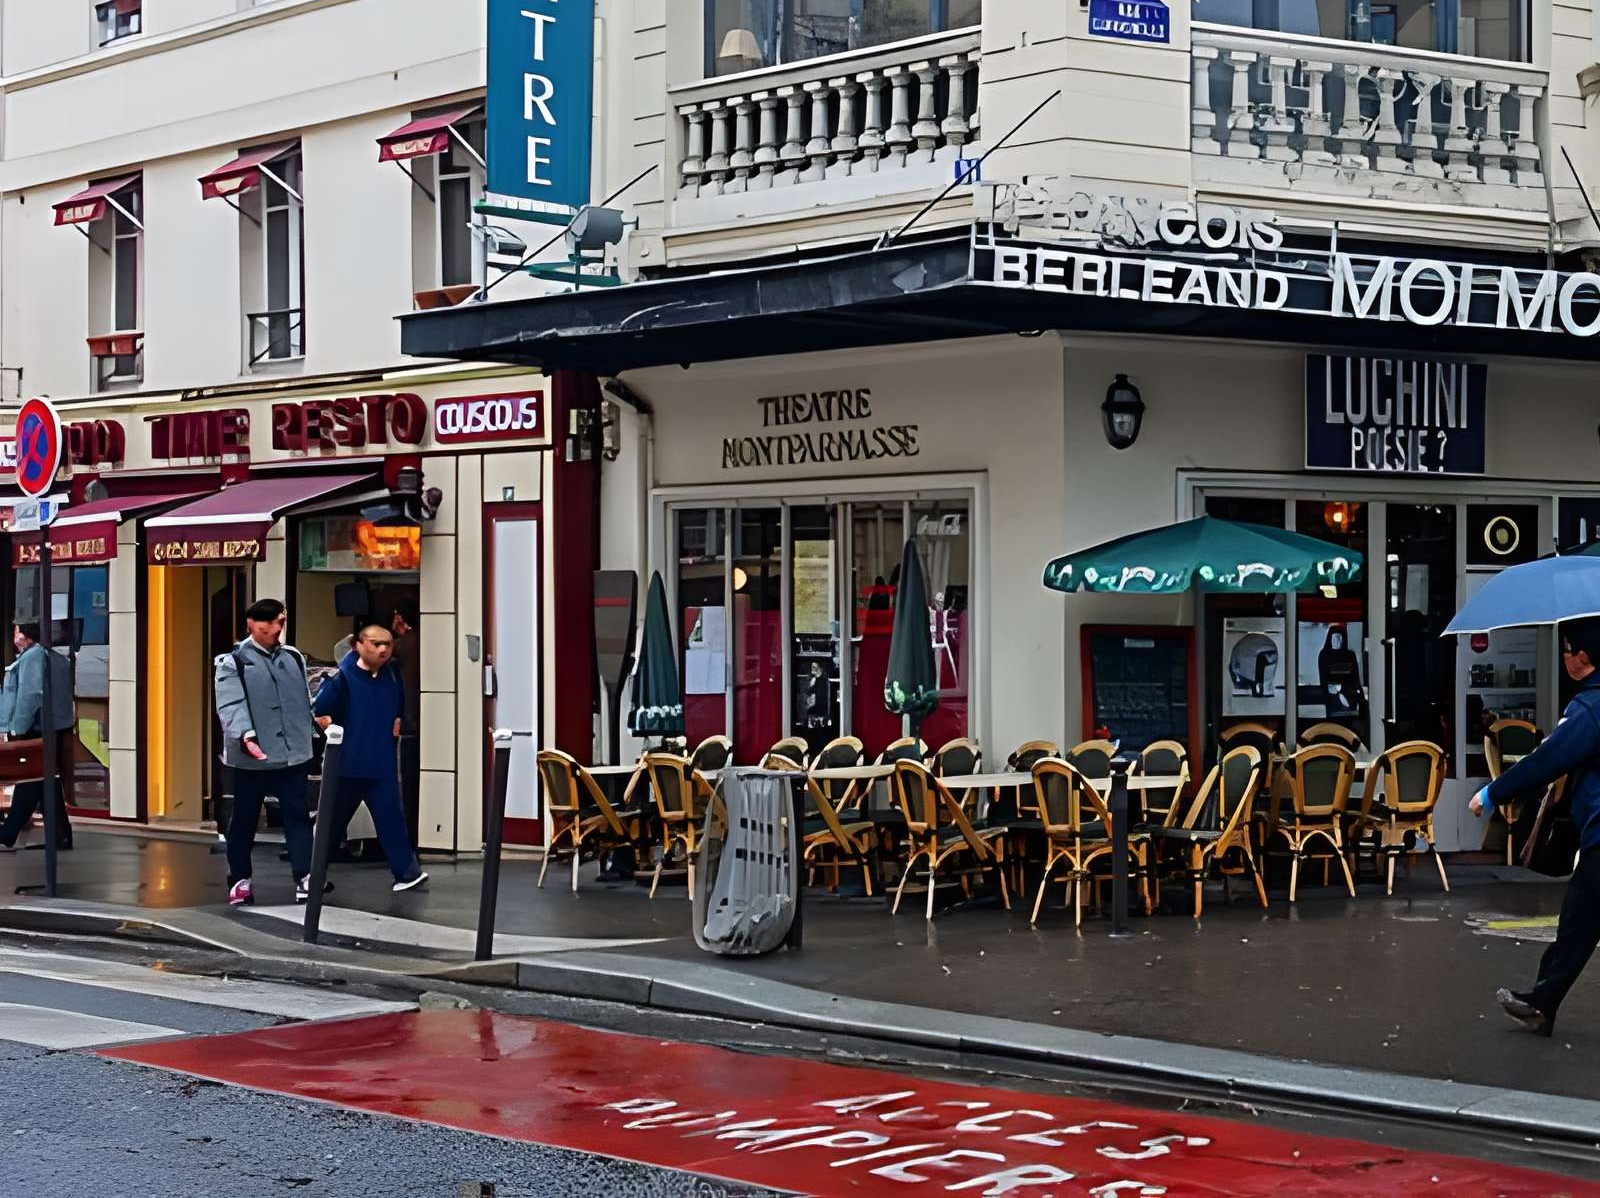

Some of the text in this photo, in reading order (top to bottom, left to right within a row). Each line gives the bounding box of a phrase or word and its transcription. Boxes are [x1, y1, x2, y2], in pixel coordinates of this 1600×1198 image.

[1331, 252, 1473, 326] MOI
[757, 388, 872, 427] THEATRE
[1326, 354, 1468, 429] LUCHINI
